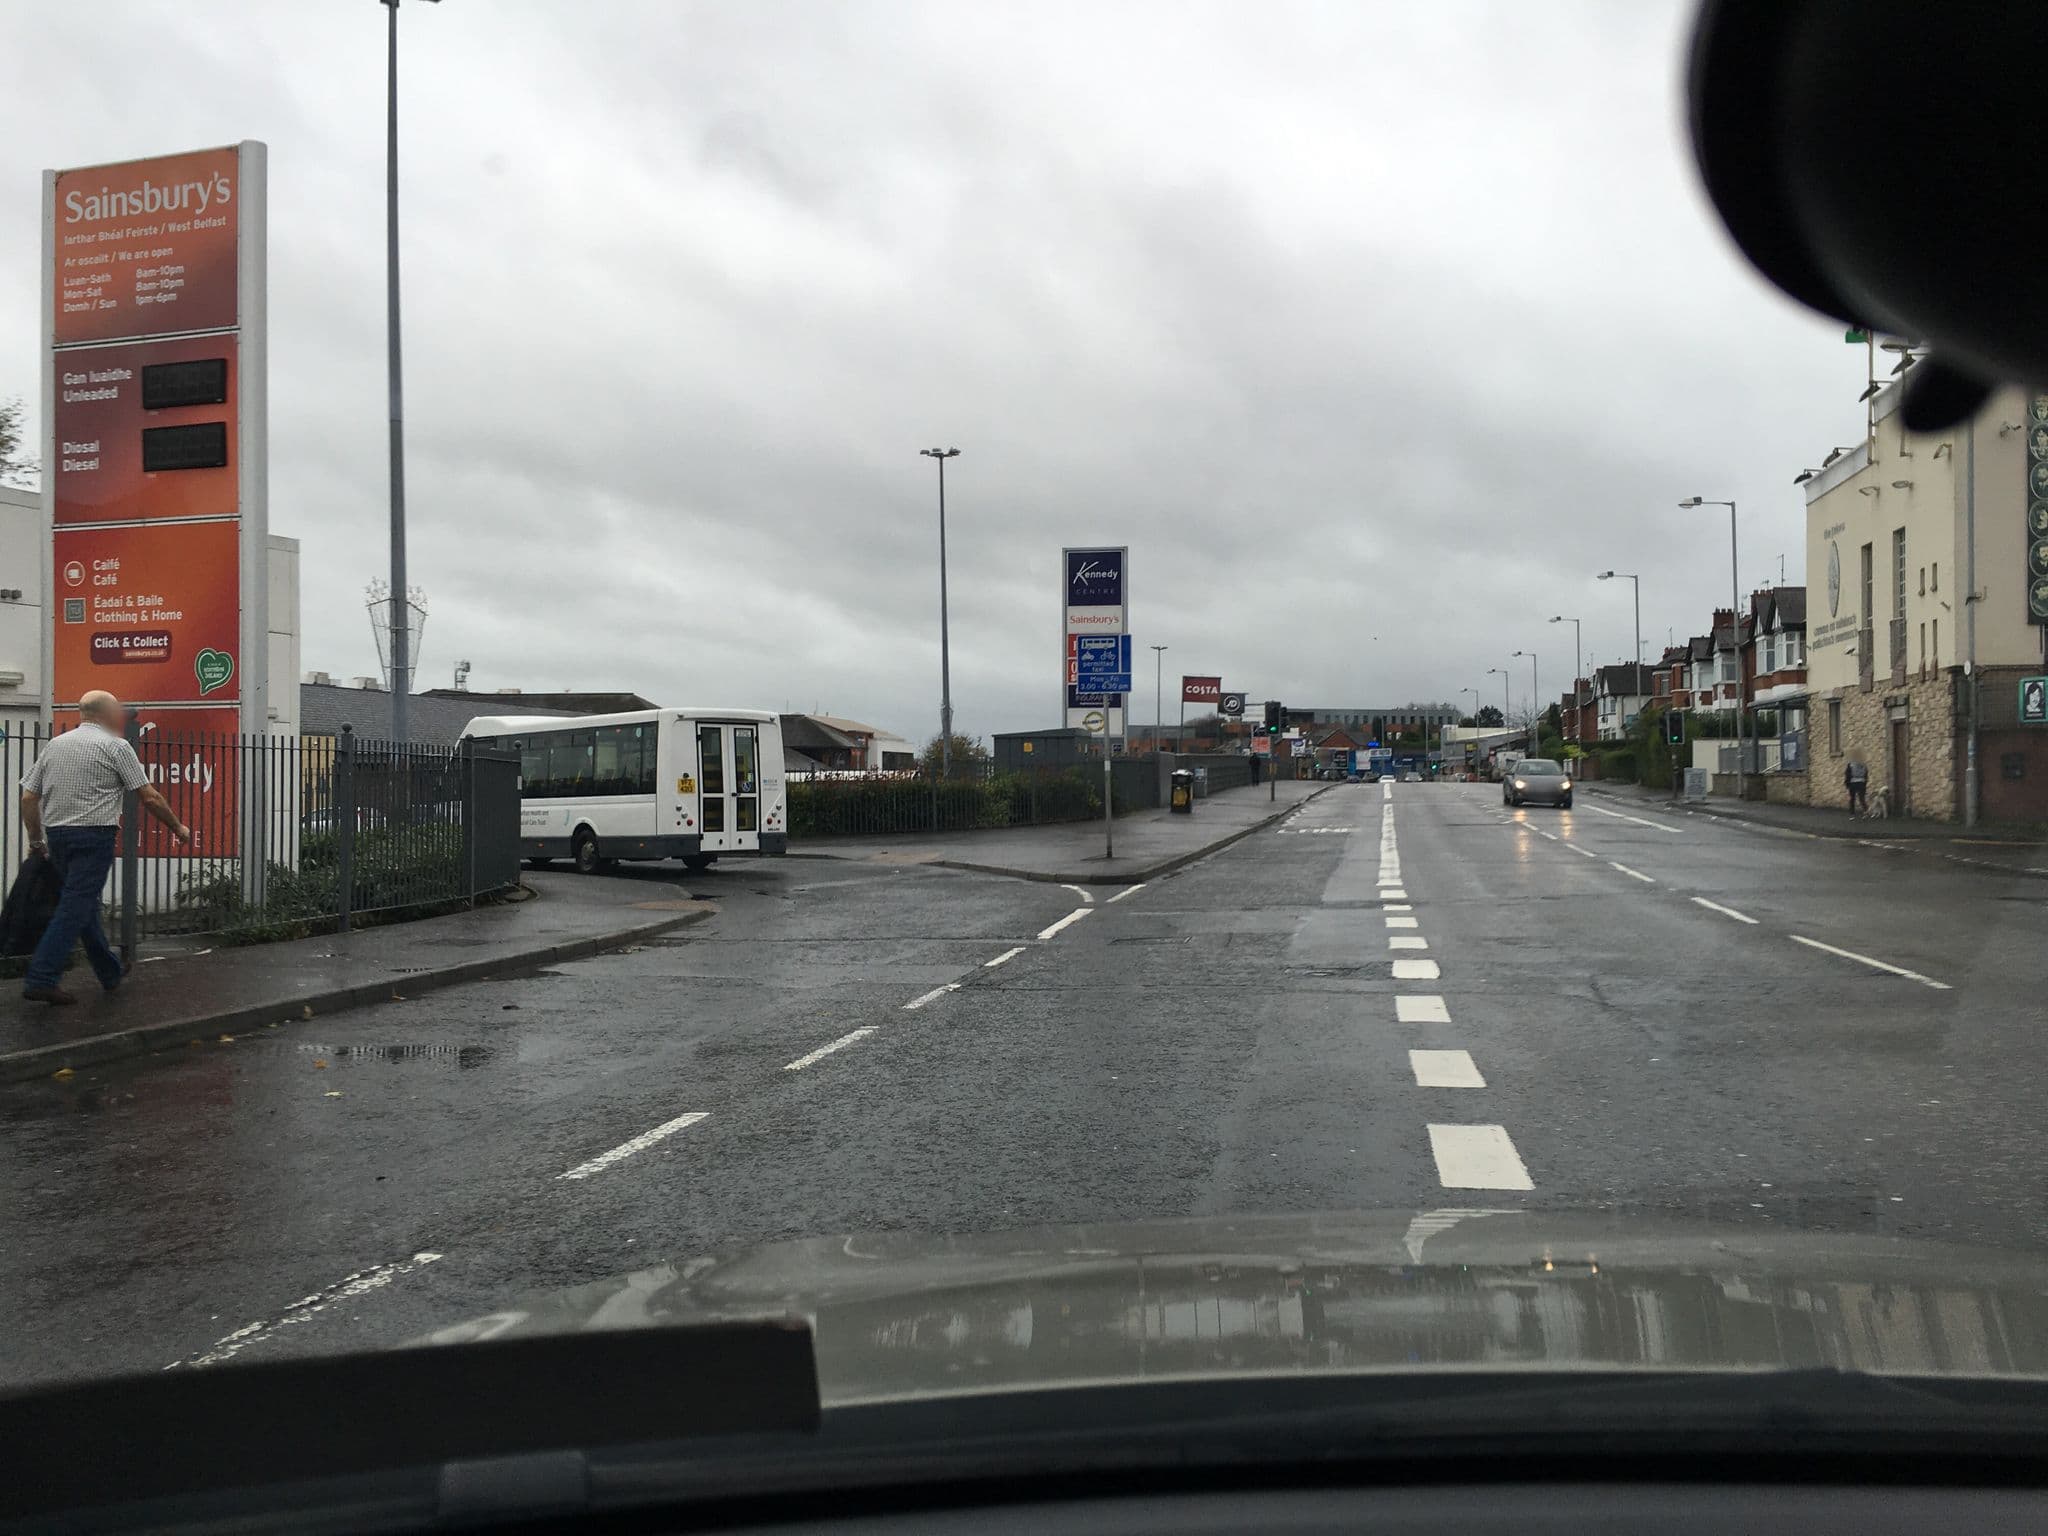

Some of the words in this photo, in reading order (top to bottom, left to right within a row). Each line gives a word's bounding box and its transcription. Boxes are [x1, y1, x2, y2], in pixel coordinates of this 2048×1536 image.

[65, 171, 231, 223] Sainsbury's
[126, 226, 158, 239] Feirste
[168, 220, 191, 232] West
[193, 215, 227, 230] Belfast
[118, 250, 132, 261] We
[134, 250, 149, 259] are
[151, 247, 174, 258] open
[63, 286, 102, 300] Mon-Sat
[136, 279, 185, 292] 8am-10pm
[99, 299, 118, 309] Sun
[63, 372, 88, 385] Gan
[63, 386, 118, 402] Unleaded
[63, 457, 99, 472] Diesel
[93, 573, 118, 586] Café
[1073, 561, 1119, 586] Kennedy
[126, 596, 135, 607] &
[137, 594, 164, 606] Baile
[94, 611, 138, 624] Clothing
[141, 610, 149, 621] &
[152, 609, 183, 621] Home
[1069, 615, 1120, 625] Sainsbury's
[94, 636, 120, 648] Click
[122, 636, 130, 648] &
[133, 635, 168, 647] Collect
[1083, 660, 1114, 669] permitted
[1185, 685, 1218, 695] COSTA
